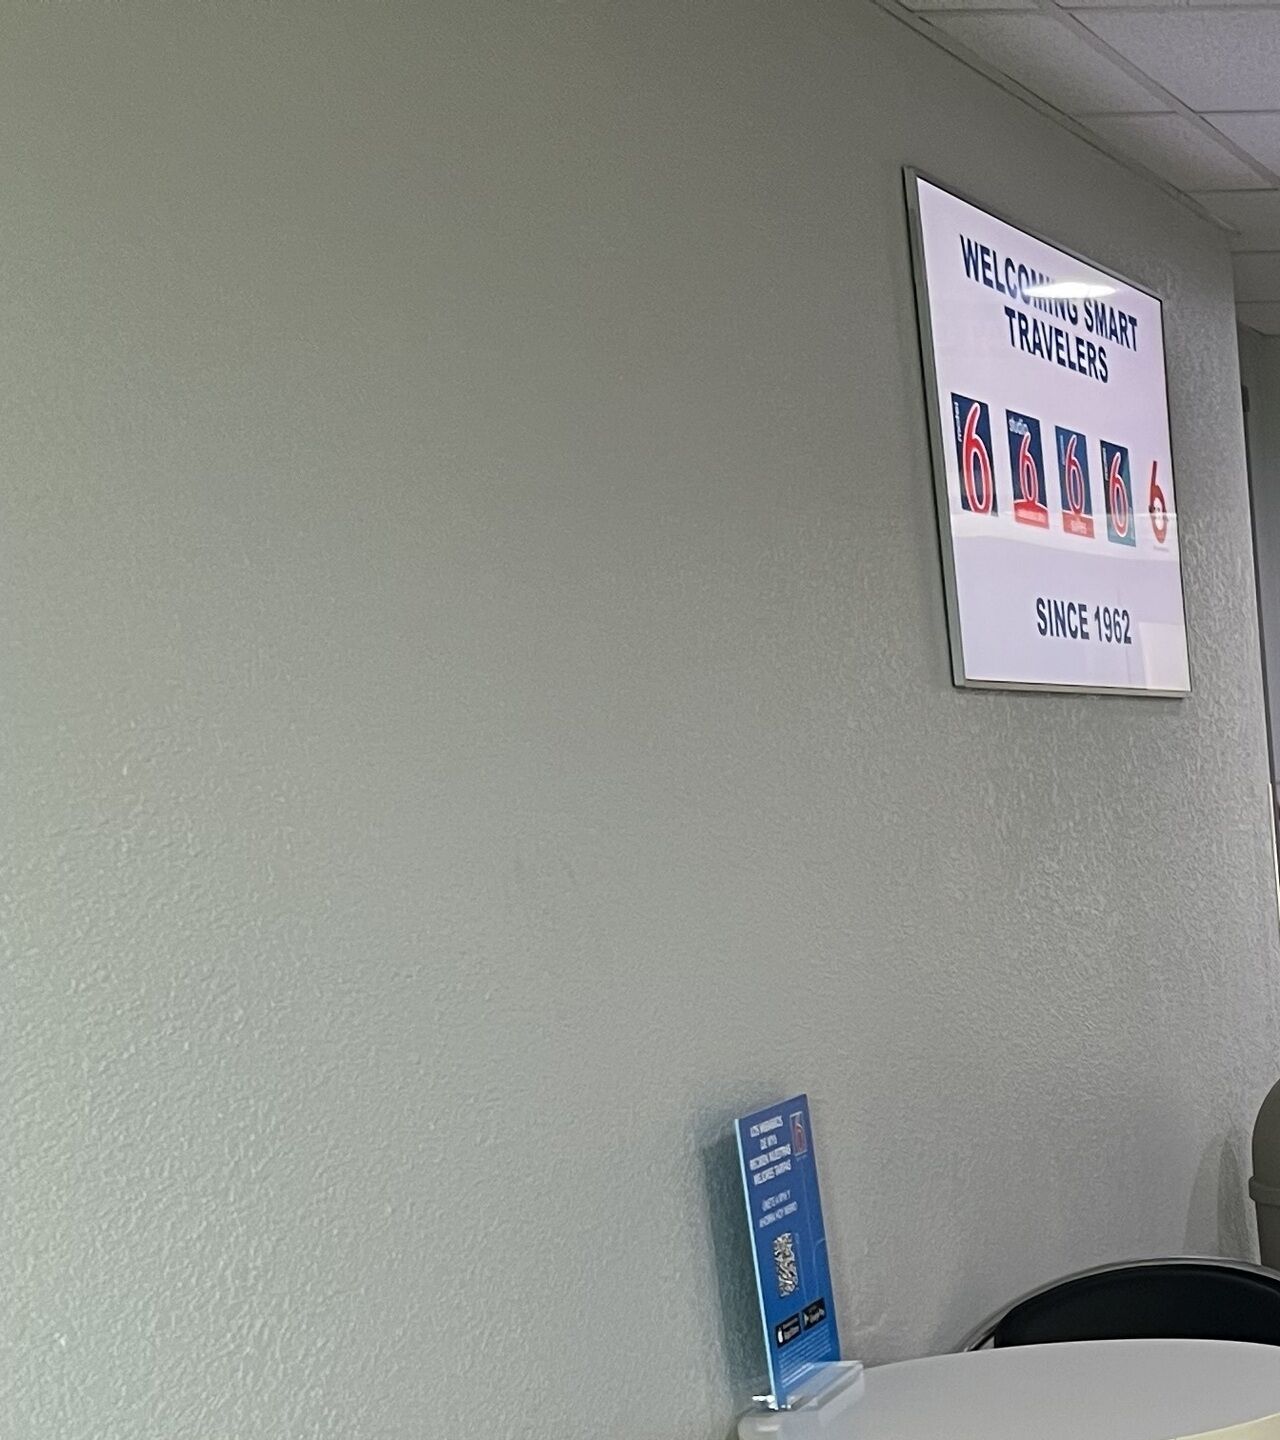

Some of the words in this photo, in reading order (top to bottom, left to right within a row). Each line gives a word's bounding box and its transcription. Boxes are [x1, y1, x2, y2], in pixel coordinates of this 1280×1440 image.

[960, 234, 1078, 325] WELCOMING
[1084, 298, 1138, 352] SMART
[1004, 306, 1109, 383] TRAVELERS
[963, 402, 993, 515] 6
[1019, 432, 1038, 504] 6
[1065, 434, 1084, 514] 6
[1109, 452, 1128, 537] 6
[1036, 597, 1090, 640] SINCE
[1094, 605, 1132, 644] 1962
